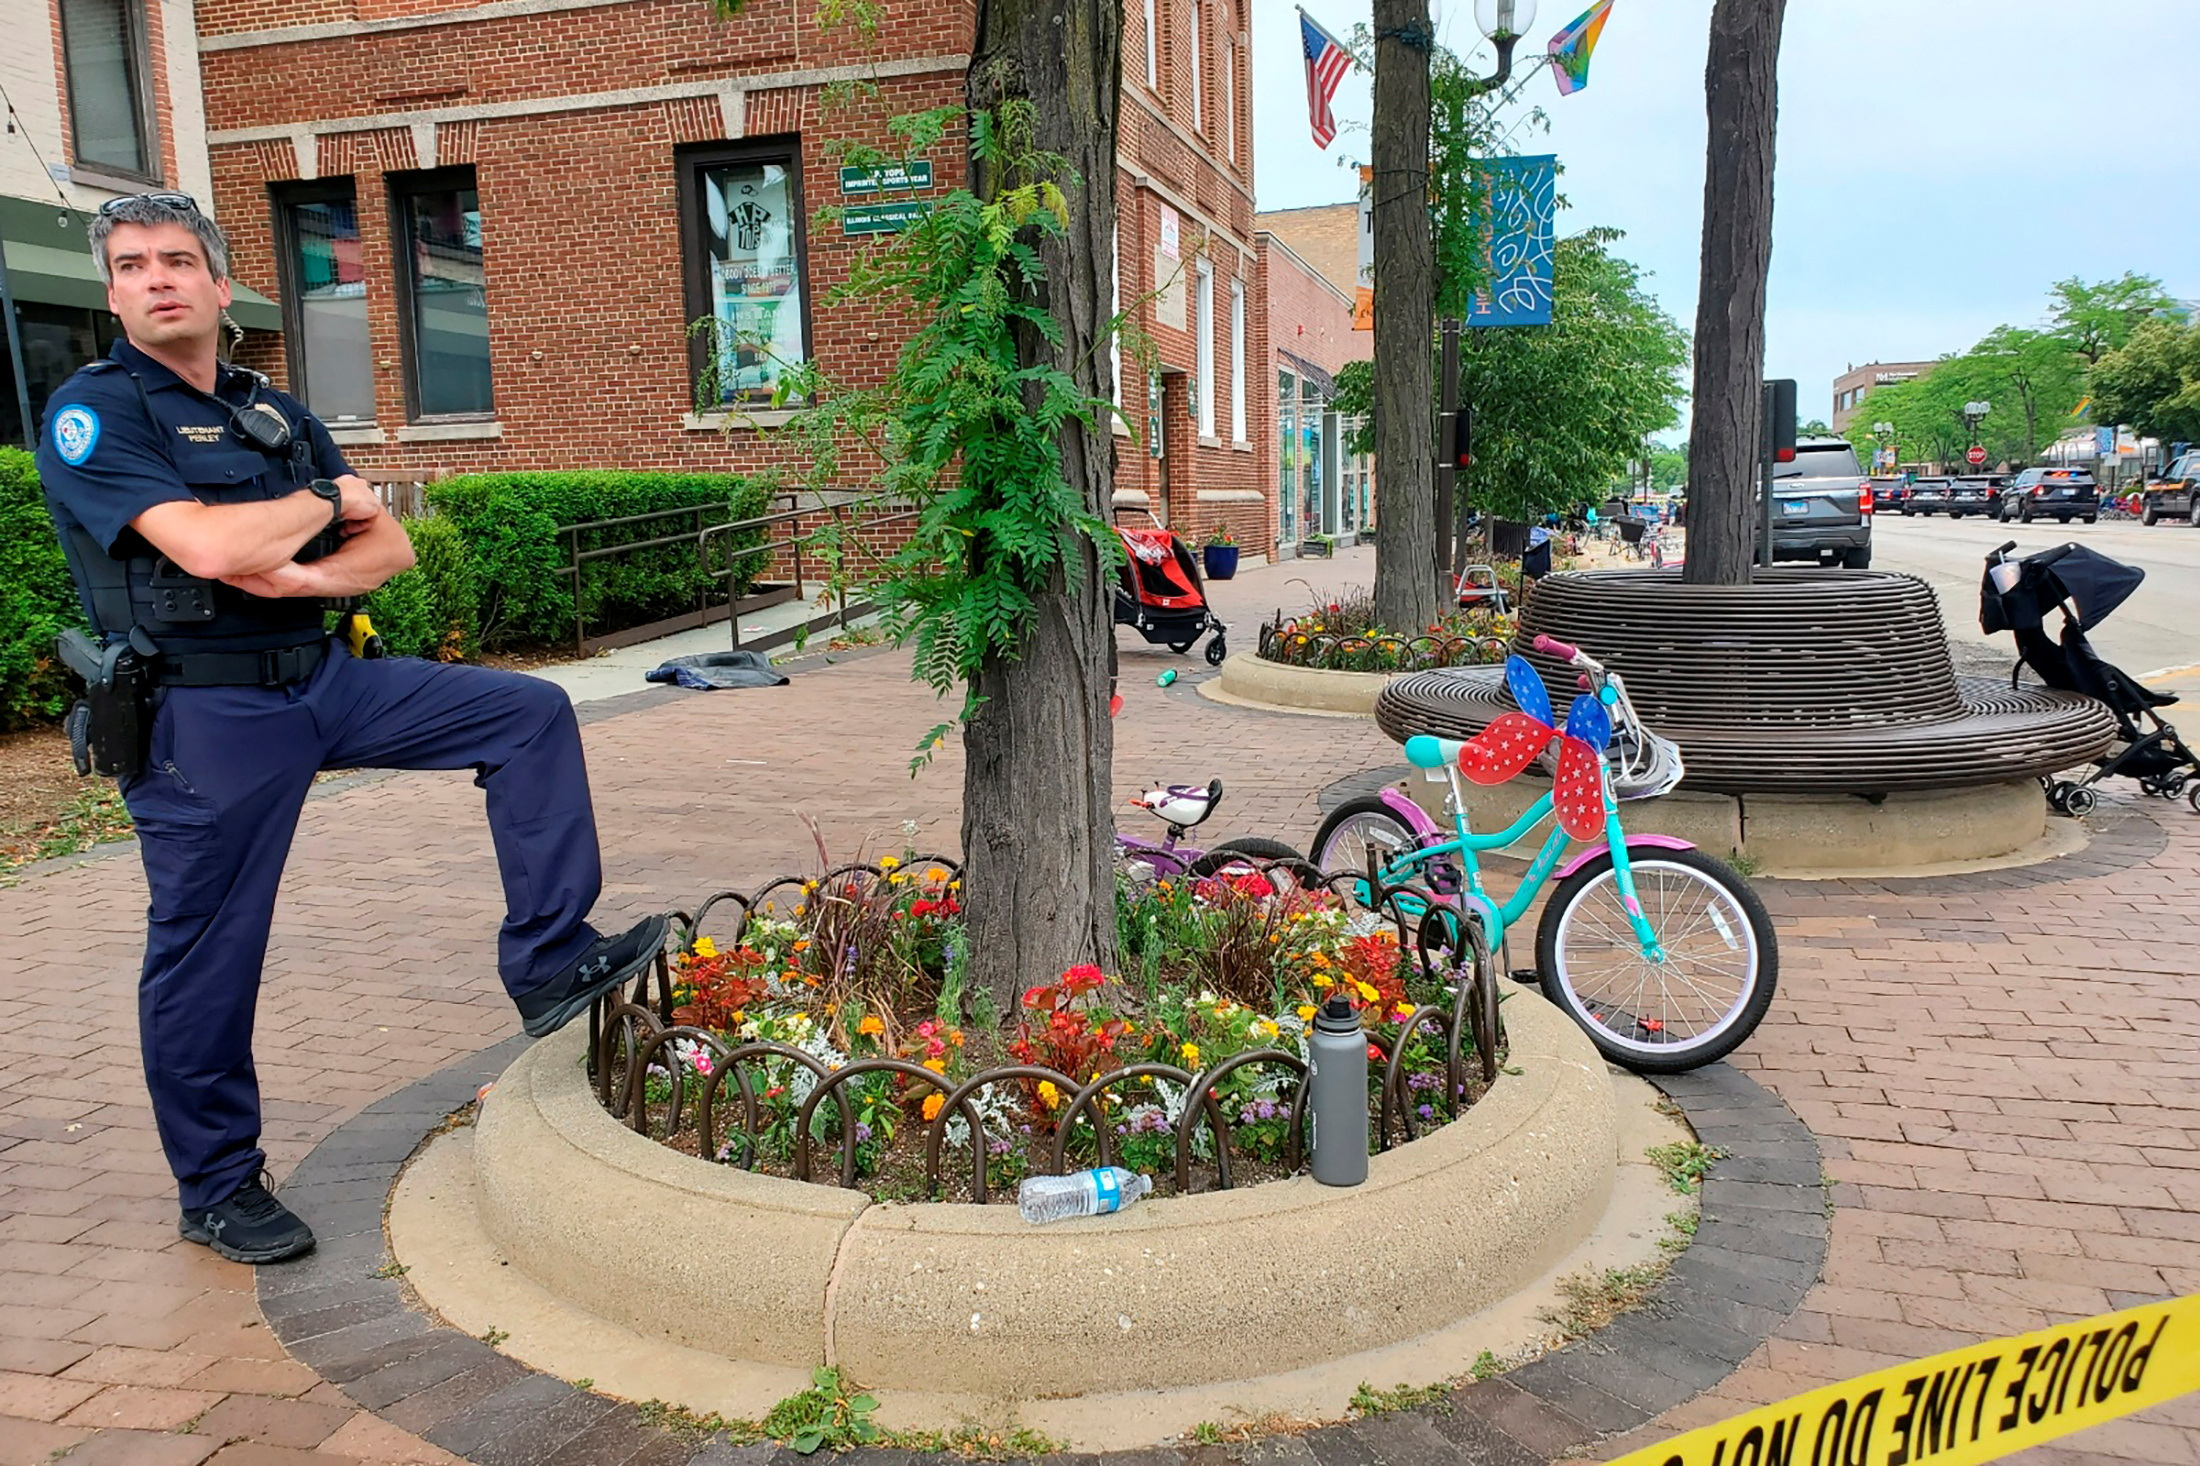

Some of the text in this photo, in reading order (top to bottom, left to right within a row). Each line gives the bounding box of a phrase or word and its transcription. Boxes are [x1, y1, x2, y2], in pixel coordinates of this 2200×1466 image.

[885, 169, 904, 177] TOPS
[176, 426, 224, 434] LIEUTENANT
[1968, 451, 1985, 459] STOP
[1998, 1314, 2170, 1433] POLICE
[1811, 1388, 1885, 1466] DO
[1887, 1355, 2003, 1466] LINE
